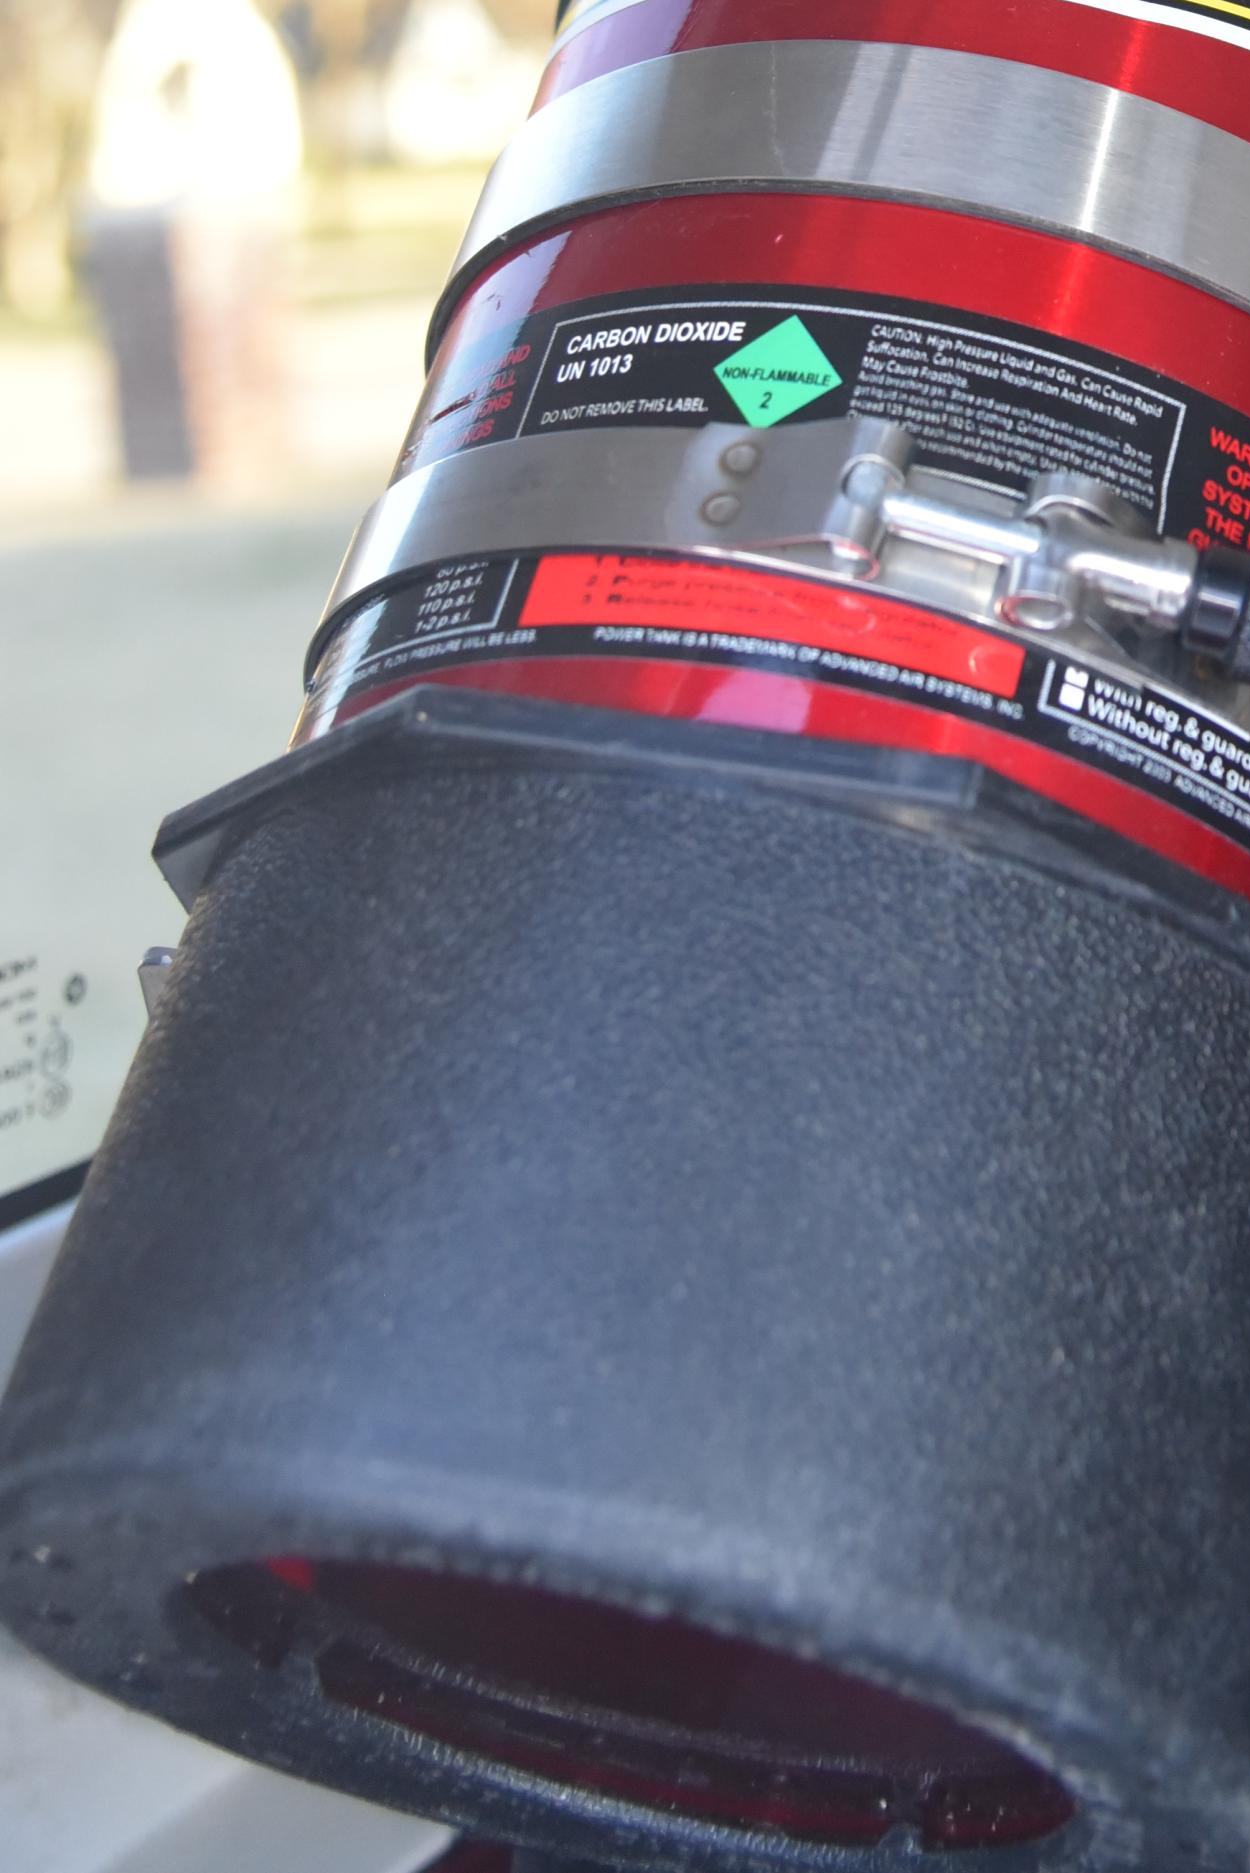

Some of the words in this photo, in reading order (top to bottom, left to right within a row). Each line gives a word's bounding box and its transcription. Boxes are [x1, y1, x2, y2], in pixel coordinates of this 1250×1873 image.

[566, 324, 652, 355] CARBON
[653, 321, 747, 343] DIOXIDE
[556, 360, 586, 383] UN
[589, 353, 634, 377] 1013
[722, 367, 832, 387] NON-FLAMMABLE
[862, 355, 884, 373] May
[886, 359, 920, 378] Cause
[920, 366, 969, 388] Frostbite.
[866, 339, 929, 362] Suffocation.
[932, 351, 954, 368] Can
[955, 357, 999, 380] Increase
[1000, 368, 1060, 396] Respiration
[1060, 387, 1083, 405] And
[1083, 396, 1112, 416] Heart
[1112, 405, 1138, 426] Rate.
[926, 334, 953, 351] High
[954, 339, 999, 363] Pressure
[1000, 351, 1034, 371] Liquid
[1034, 363, 1056, 378] and
[1081, 377, 1101, 394] Can
[1102, 384, 1133, 406] Cause
[1133, 396, 1163, 418] Rapid
[540, 410, 560, 425] DO
[560, 405, 586, 421] NOT
[585, 399, 637, 418] REMOVE
[637, 398, 666, 413] THIS
[665, 397, 708, 413] LABEL.
[759, 391, 773, 409] 2
[1205, 507, 1244, 545] THE
[425, 580, 450, 599] 120
[417, 598, 442, 617] 110
[410, 638, 462, 660] PRESSURE
[593, 625, 645, 642] POWER
[646, 628, 681, 645] TANK
[682, 630, 698, 647] IS
[698, 633, 709, 647] A
[709, 633, 796, 659] TRADEMARK
[797, 645, 820, 663] OF
[819, 651, 899, 682] ADVANCED
[899, 669, 925, 690] AIR
[1088, 693, 1170, 750] Without
[1171, 739, 1208, 772] reg.
[1209, 755, 1225, 779] &
[1145, 699, 1182, 733] reg.
[1183, 716, 1200, 741] &
[1068, 725, 1143, 769] COPYRIGHT
[1174, 775, 1235, 818] ADVANCED
